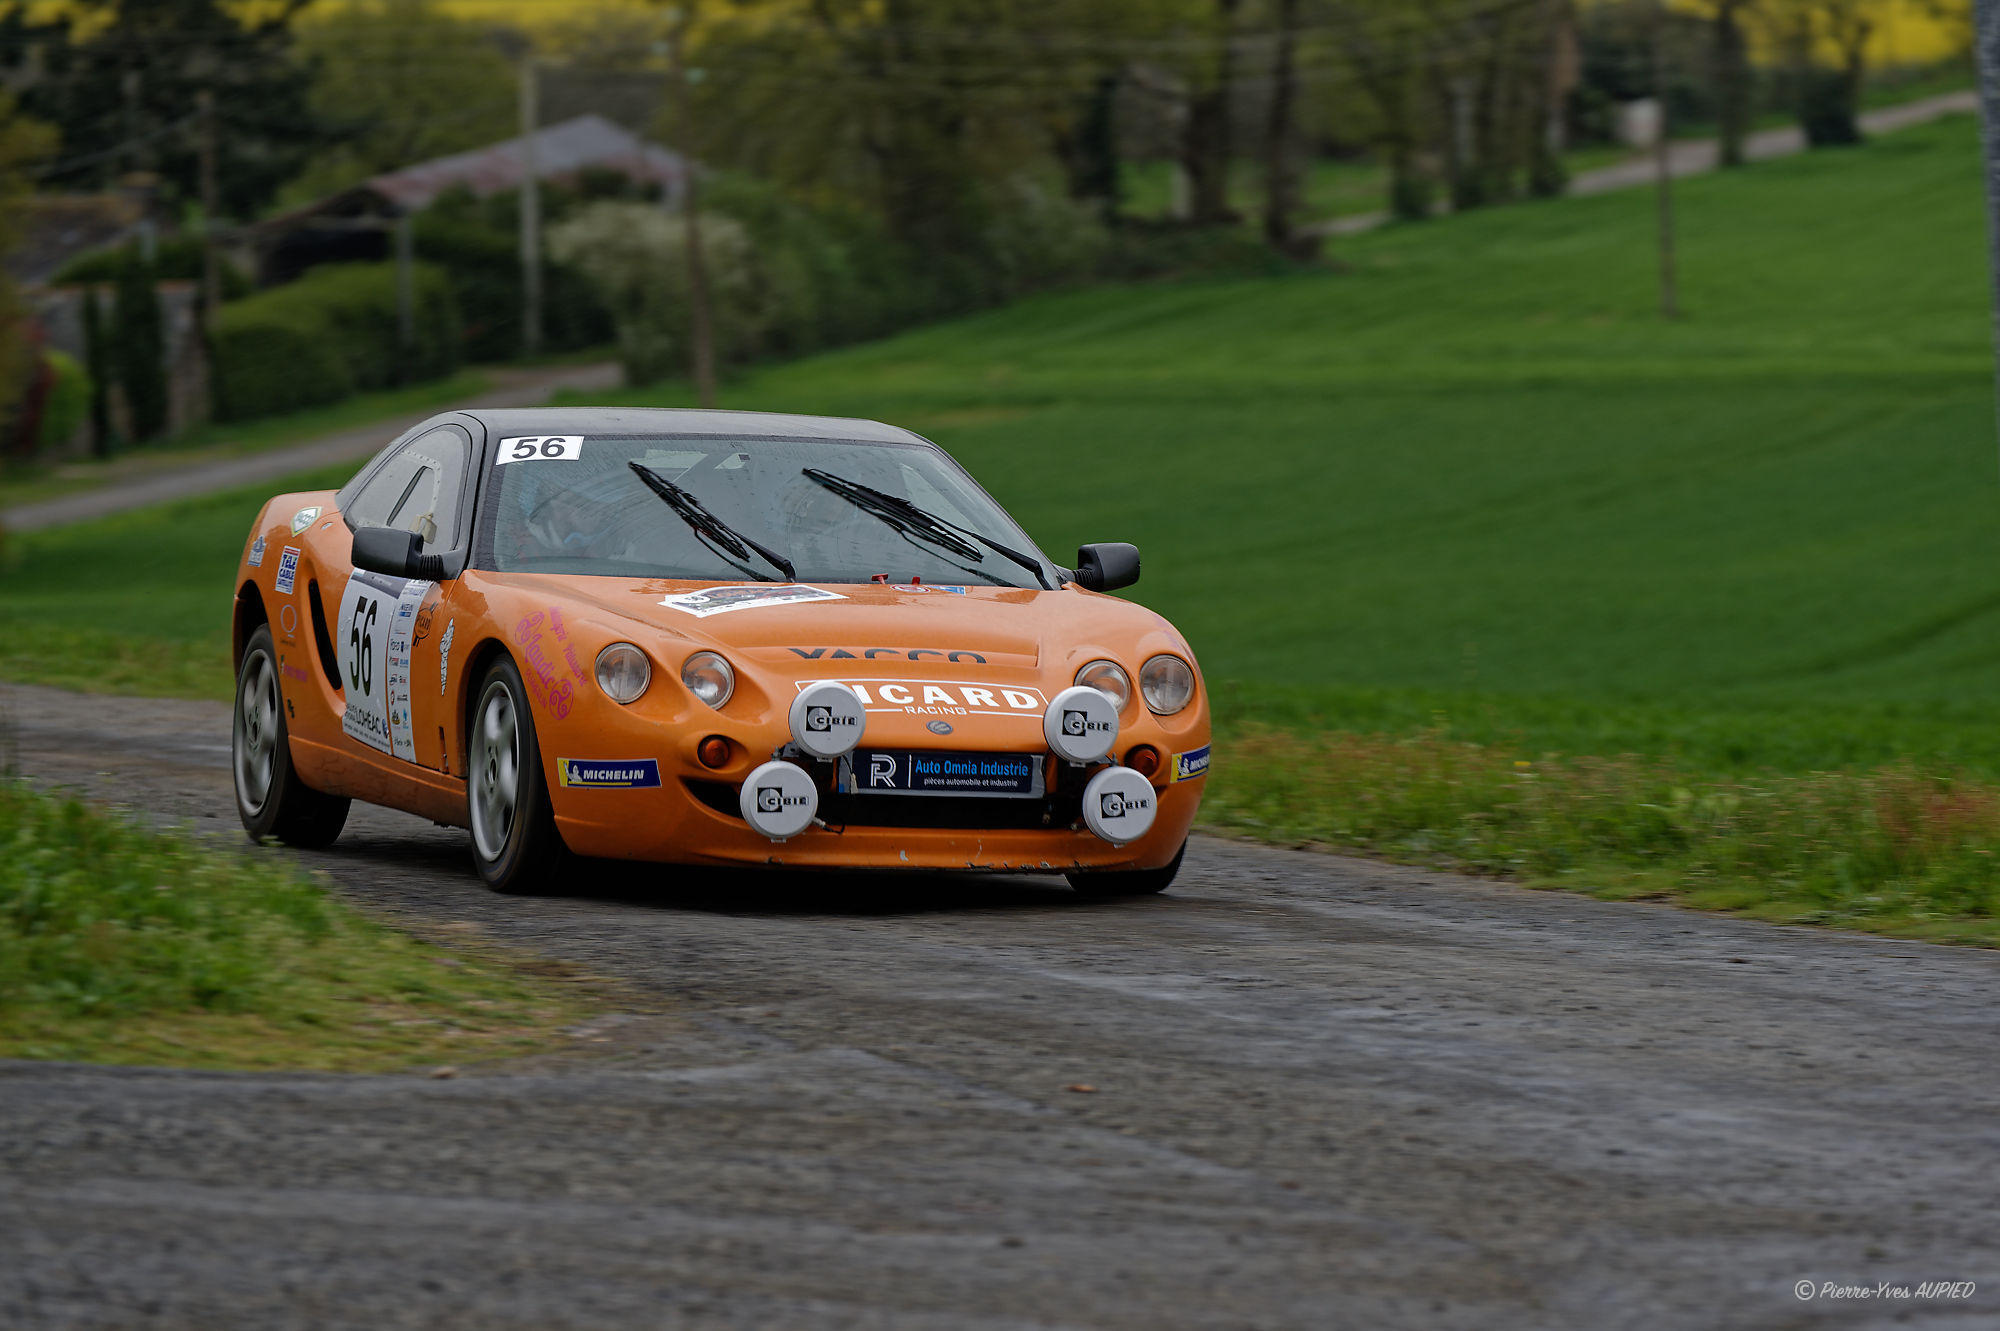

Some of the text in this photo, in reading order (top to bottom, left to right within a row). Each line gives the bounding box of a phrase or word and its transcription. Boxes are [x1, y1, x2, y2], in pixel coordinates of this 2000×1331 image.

[512, 437, 566, 459] 56
[350, 595, 378, 697] 56
[851, 684, 1040, 709] ICARD
[905, 705, 968, 716] RACING
[583, 769, 644, 780] MICHELIN
[915, 760, 1029, 777] Auto Omnia Industrie
[924, 777, 946, 786] pièces
[946, 778, 981, 786] automobile
[990, 779, 1018, 787] industrie
